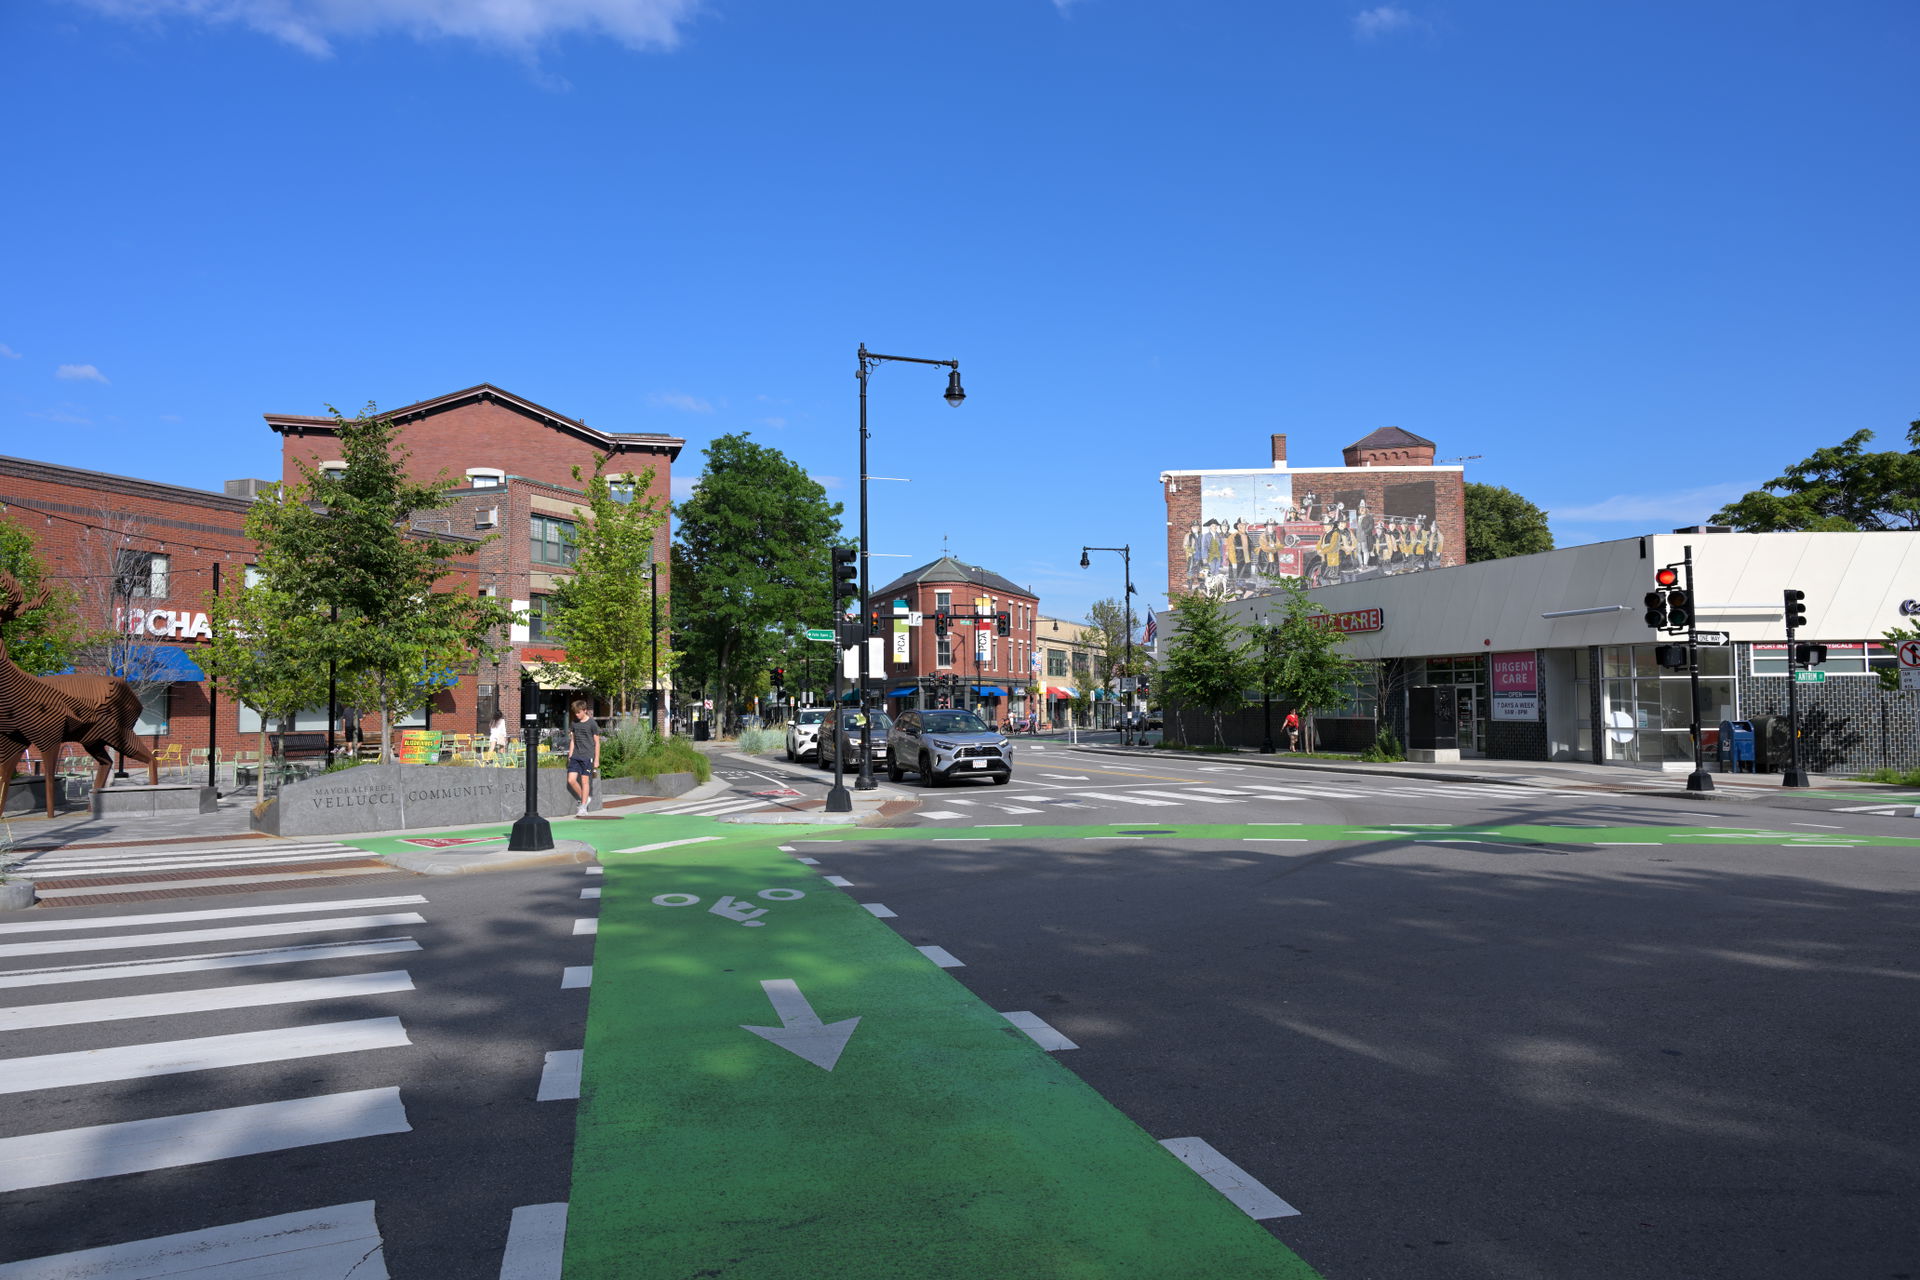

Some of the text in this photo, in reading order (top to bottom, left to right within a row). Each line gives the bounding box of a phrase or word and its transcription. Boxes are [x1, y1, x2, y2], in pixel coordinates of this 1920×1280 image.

[1340, 611, 1378, 631] CARE
[897, 634, 906, 653] PCA
[1710, 634, 1720, 642] WAY
[1495, 661, 1534, 673] URGENT
[1502, 673, 1528, 684] CARE
[1798, 672, 1818, 681] ANTRIM
[1500, 701, 1514, 709] DAYS
[1519, 701, 1535, 709] WEEK
[312, 781, 526, 809] VELLUCCI COMMUNITY PLA
[315, 786, 350, 796] MAYOR
[351, 784, 386, 794] ALFRED
